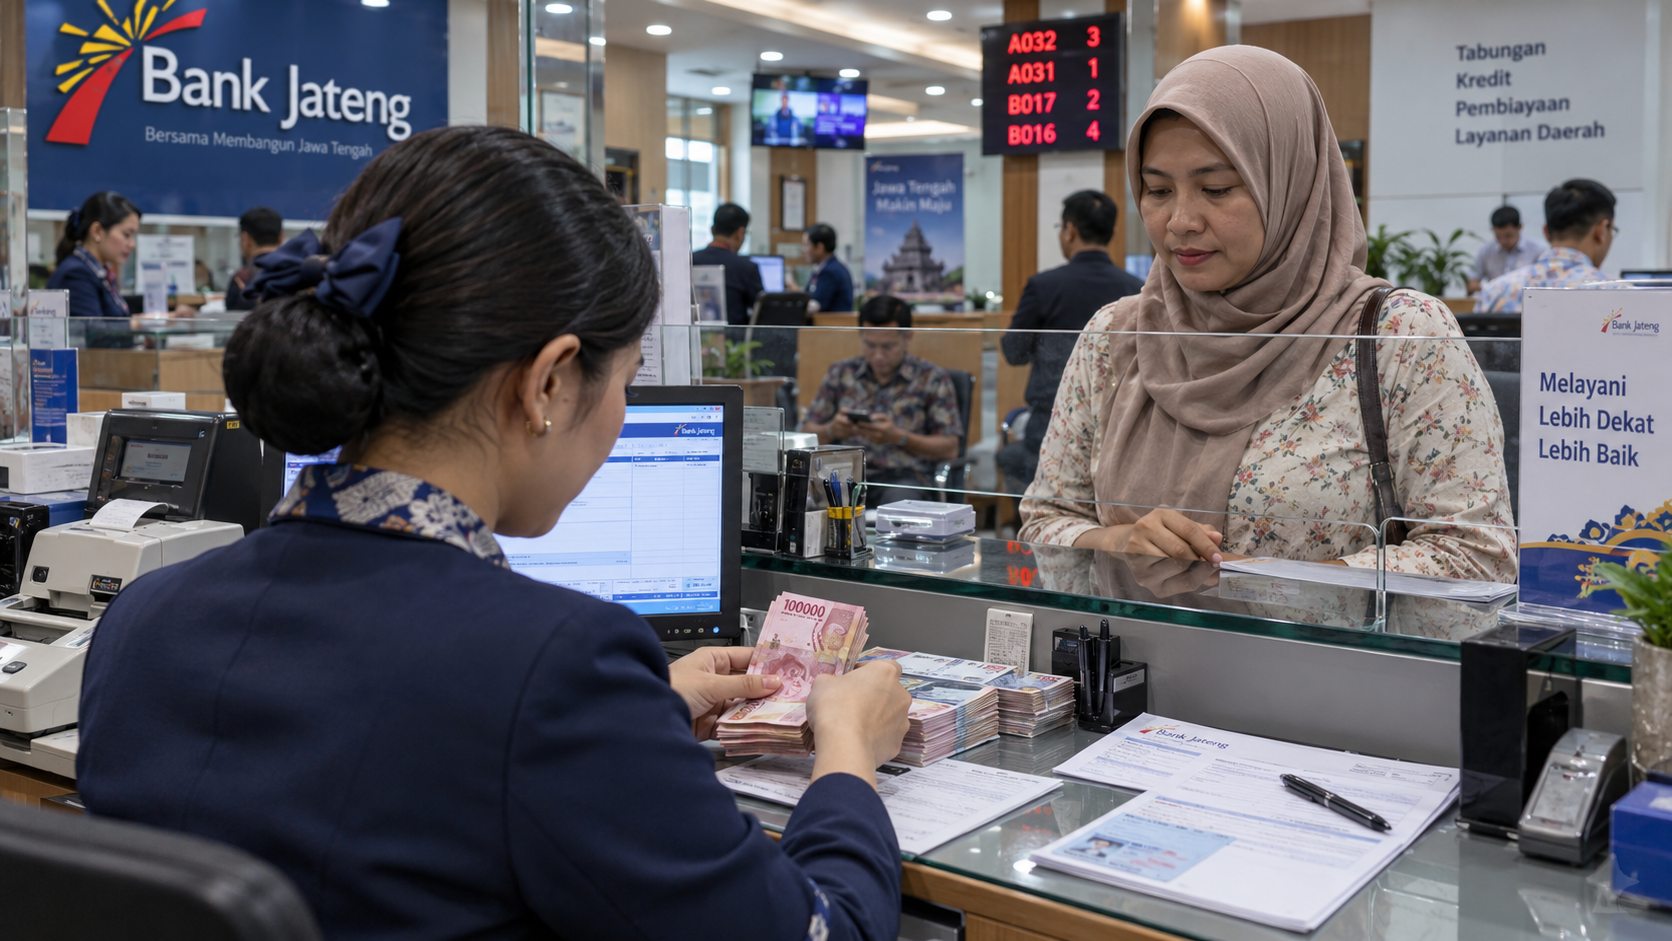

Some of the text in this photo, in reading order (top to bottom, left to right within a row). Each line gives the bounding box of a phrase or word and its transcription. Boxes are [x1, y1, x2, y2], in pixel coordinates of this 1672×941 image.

[1008, 25, 1101, 55] A032 3
[1456, 41, 1546, 63] Tabungan
[1008, 56, 1099, 85] A031 1
[1456, 69, 1512, 89] Kredit
[143, 45, 412, 141] Bank Jateng
[1008, 88, 1101, 116] B017 2
[1455, 96, 1571, 118] Pembiayaan
[145, 126, 373, 160] Bersama Membangun Jawa Tengah
[1008, 119, 1101, 146] B016 4
[1455, 120, 1606, 148] Layanan Daerah
[872, 179, 956, 198] Jawa Tengah
[876, 197, 953, 215] Makin Maju
[1612, 320, 1660, 333] Bank Jateng
[1540, 371, 1627, 400] Melayani
[1540, 405, 1655, 435] Lebih Dekat
[1539, 438, 1640, 468] Lebih Baik
[784, 599, 826, 618] 100000
[1156, 728, 1187, 740] Bank
